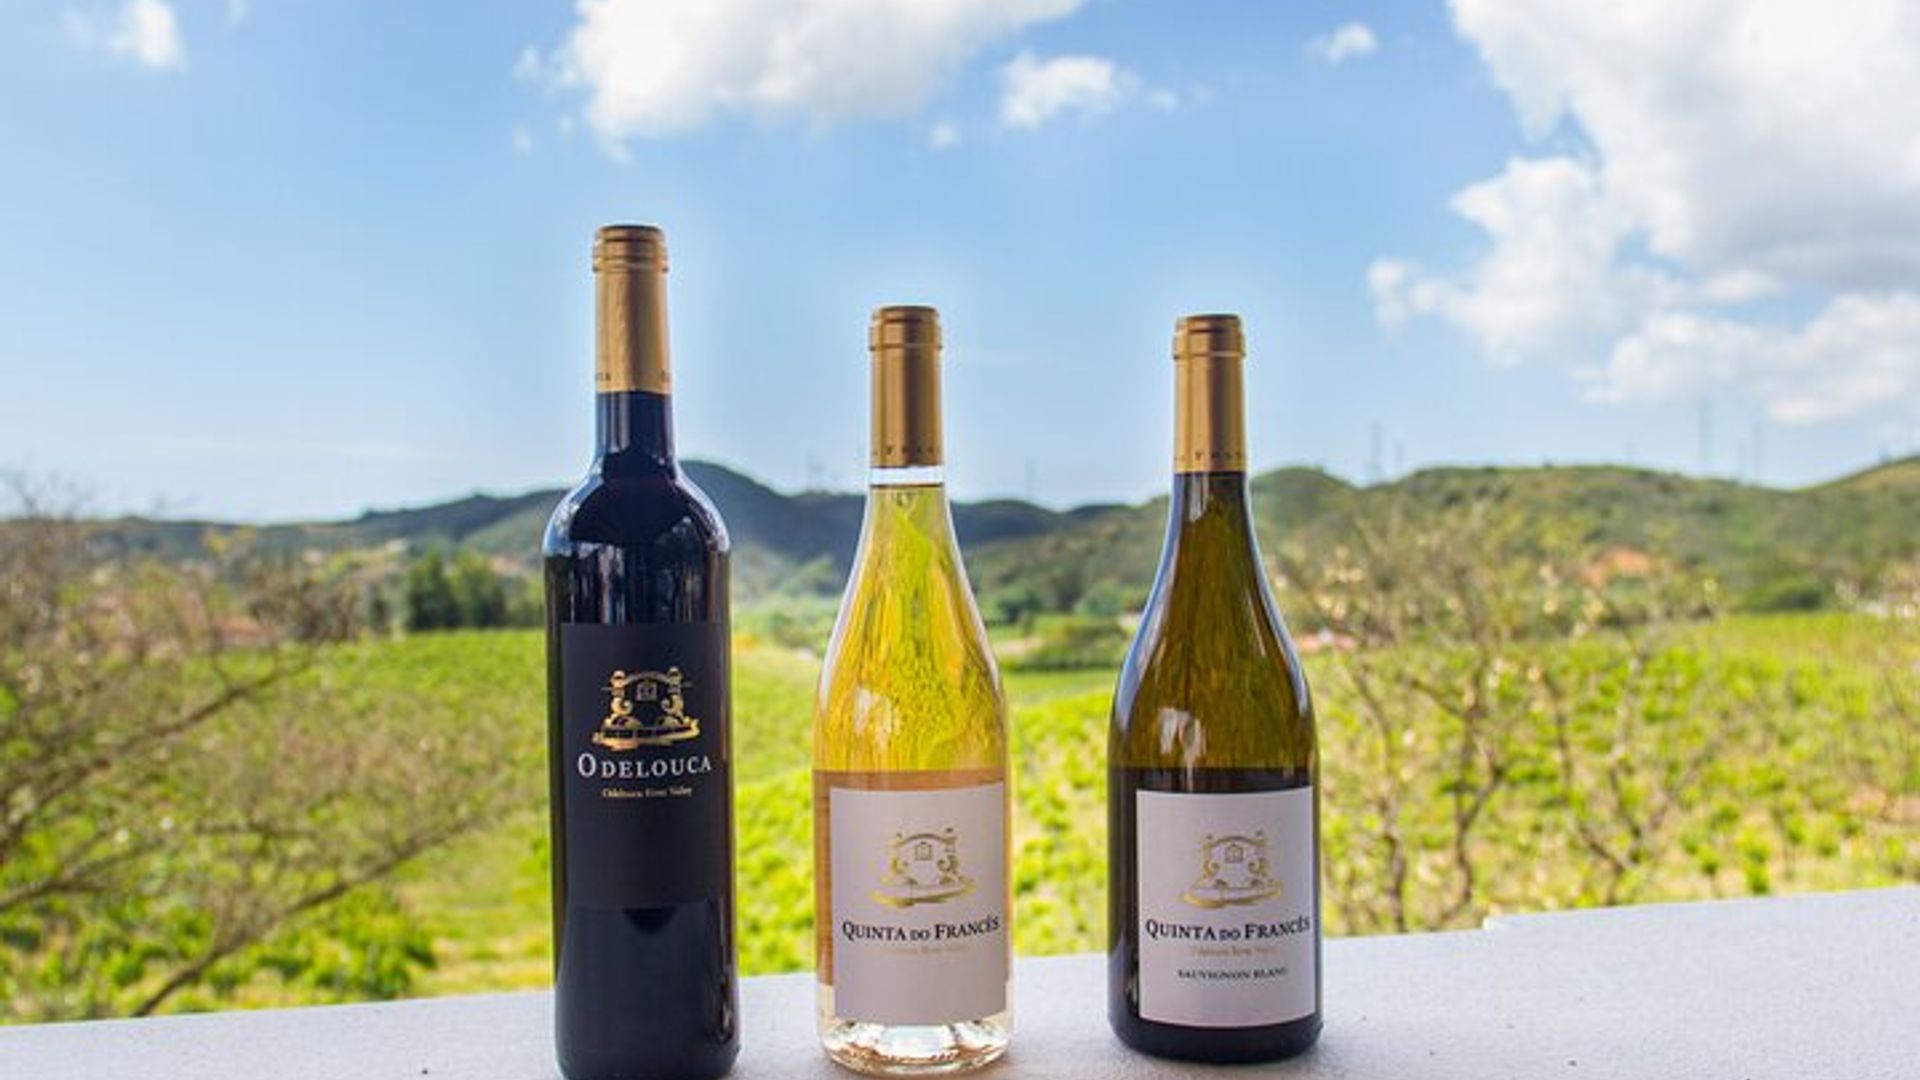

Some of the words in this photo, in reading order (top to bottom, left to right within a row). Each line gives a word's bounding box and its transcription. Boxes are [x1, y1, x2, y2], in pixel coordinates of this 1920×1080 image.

[577, 752, 712, 779] ODELOUCA
[842, 920, 907, 941] QUINTA
[1145, 918, 1217, 941] QUINTA
[1177, 968, 1250, 979] SAUVIGNON
